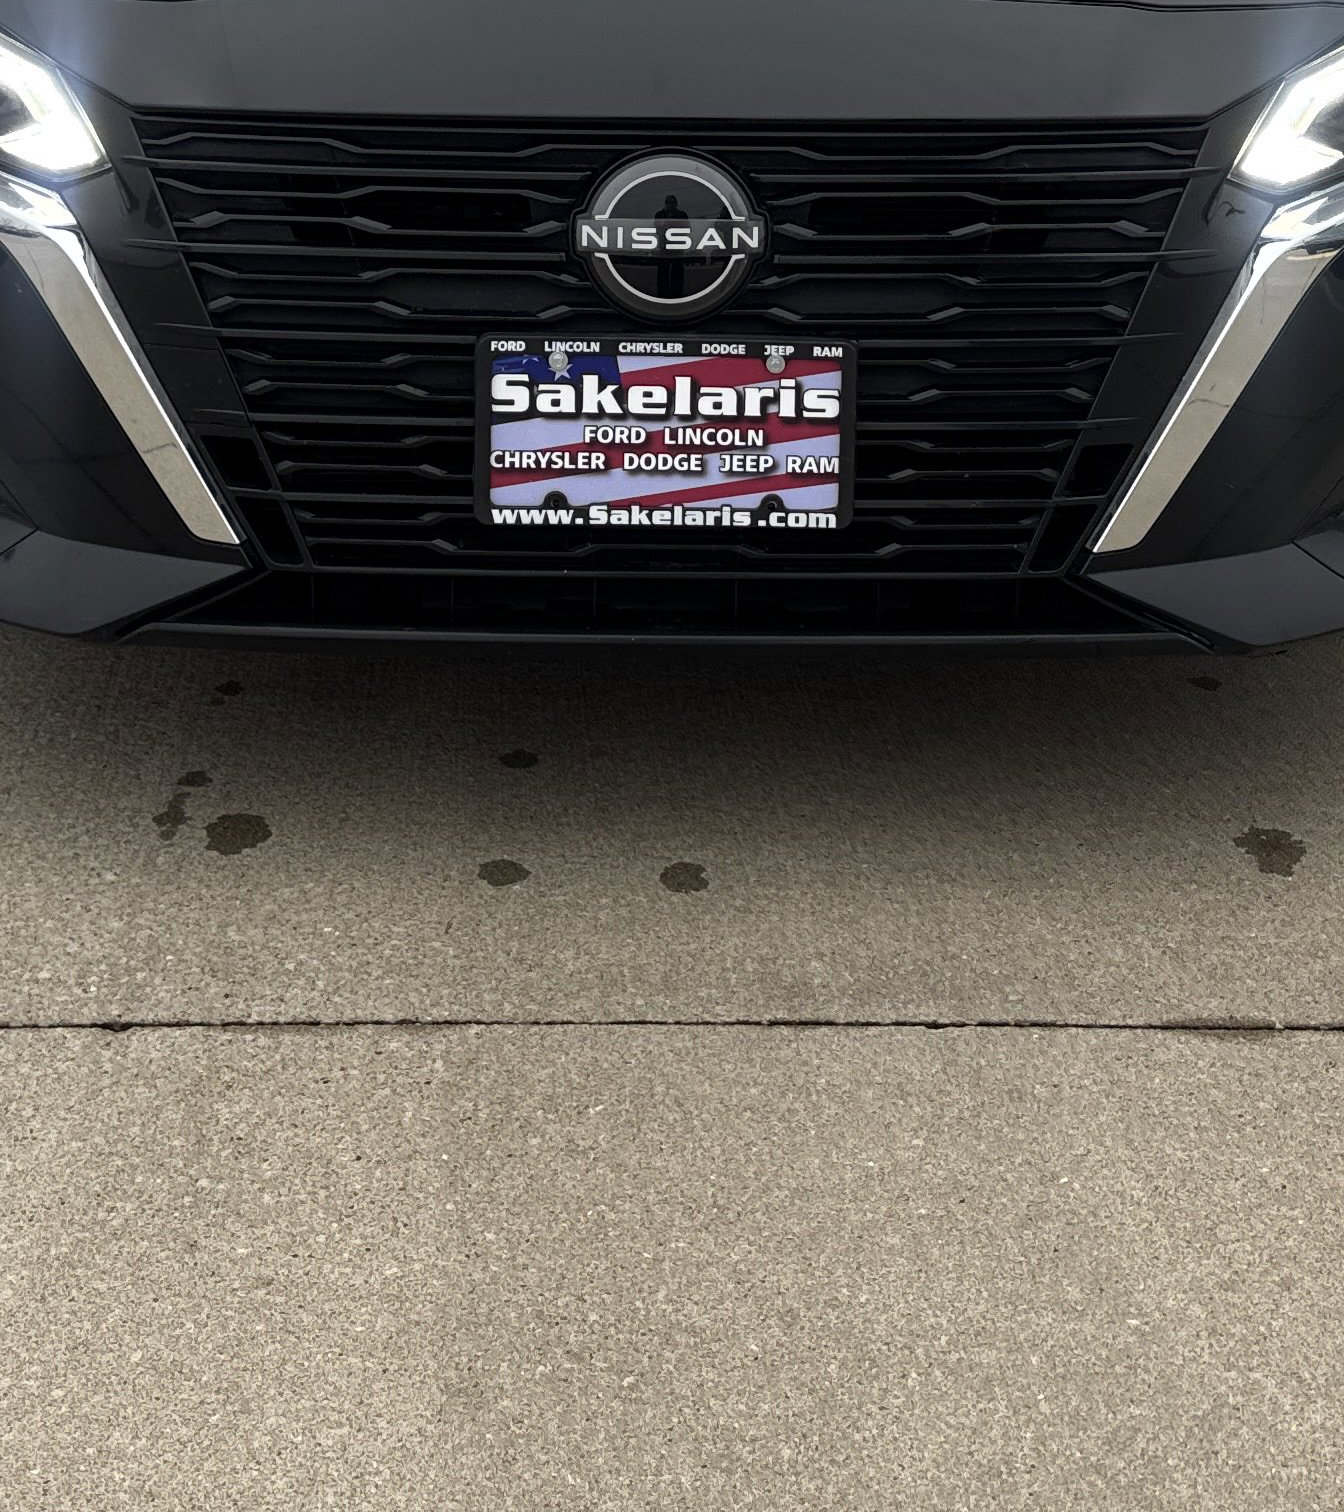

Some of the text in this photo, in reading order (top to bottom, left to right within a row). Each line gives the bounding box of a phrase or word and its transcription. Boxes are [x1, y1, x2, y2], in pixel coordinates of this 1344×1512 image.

[581, 226, 760, 250] NISSAN
[490, 340, 843, 358] FORD LINCOLN CHRYSLER DODGE JEEP RAM
[490, 373, 840, 419] Sakelaris
[583, 425, 764, 447] FORD LINCOLN
[490, 451, 840, 474] CHRYSLER DODGE JEEP RAM
